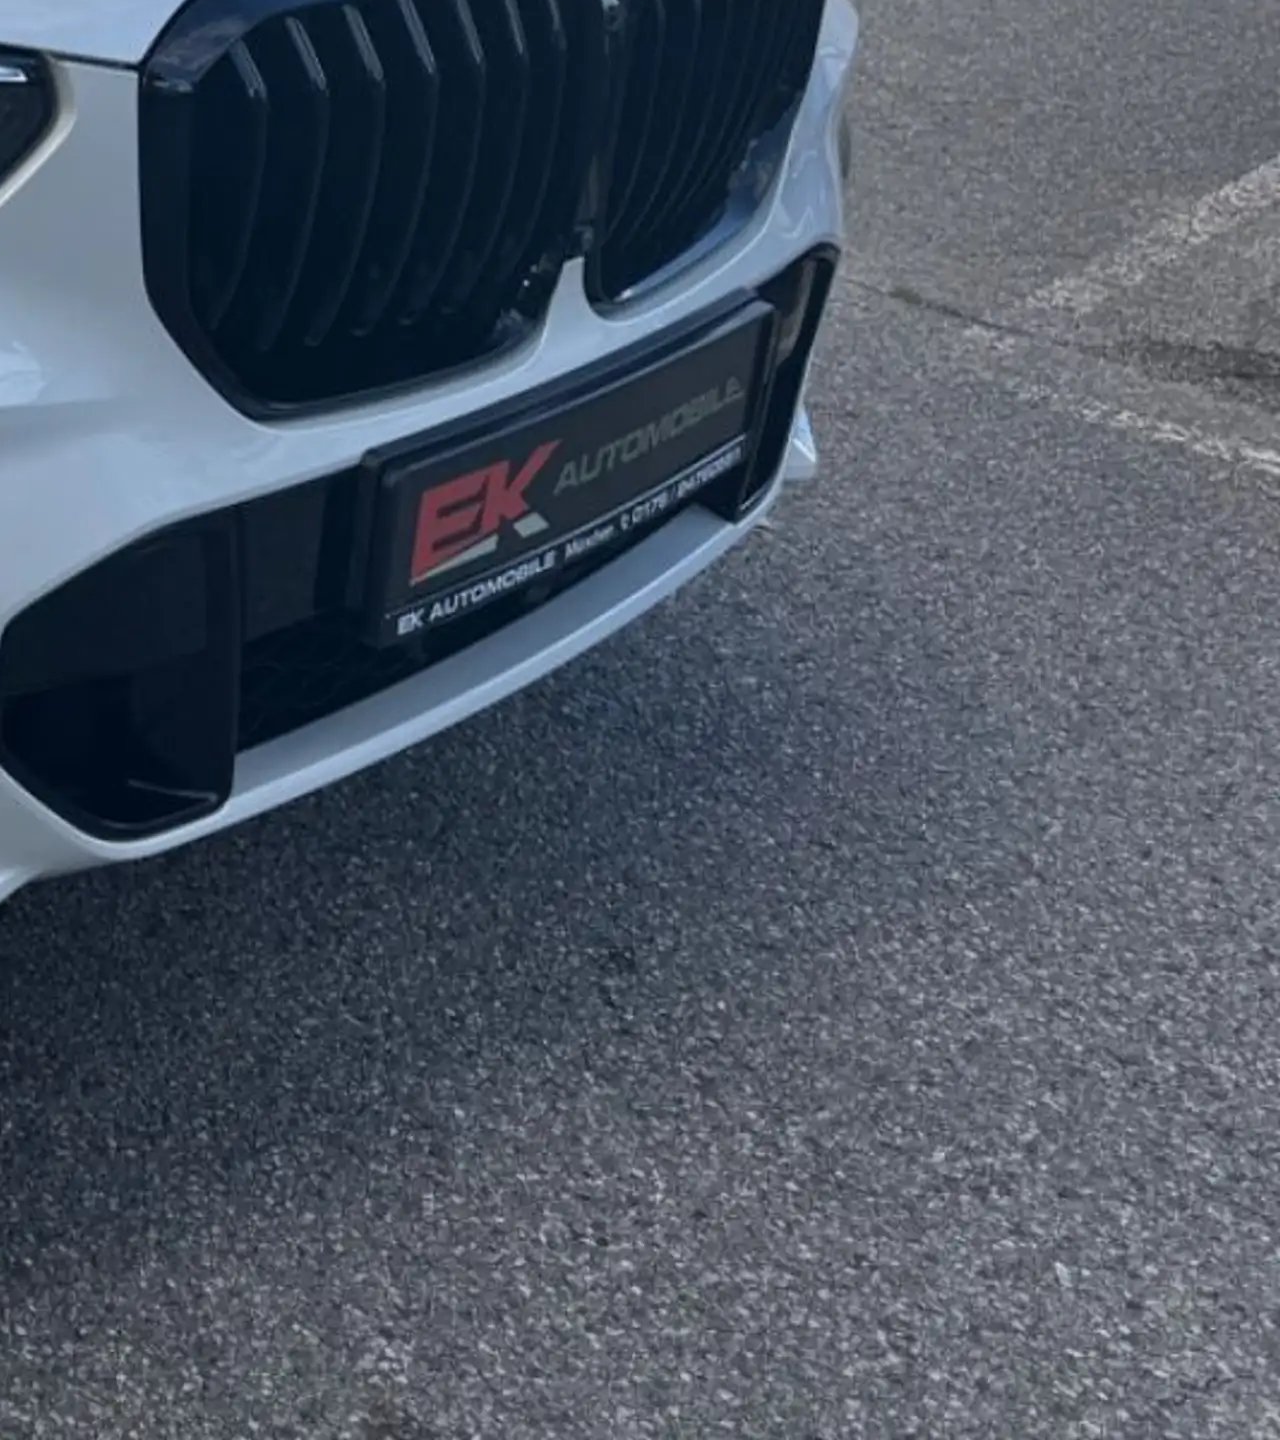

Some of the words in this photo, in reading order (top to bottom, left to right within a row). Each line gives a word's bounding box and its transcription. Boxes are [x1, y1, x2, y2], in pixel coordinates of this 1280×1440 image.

[410, 439, 562, 584] EK
[397, 609, 424, 635] EK
[428, 550, 558, 621] AUTOMOBILE
